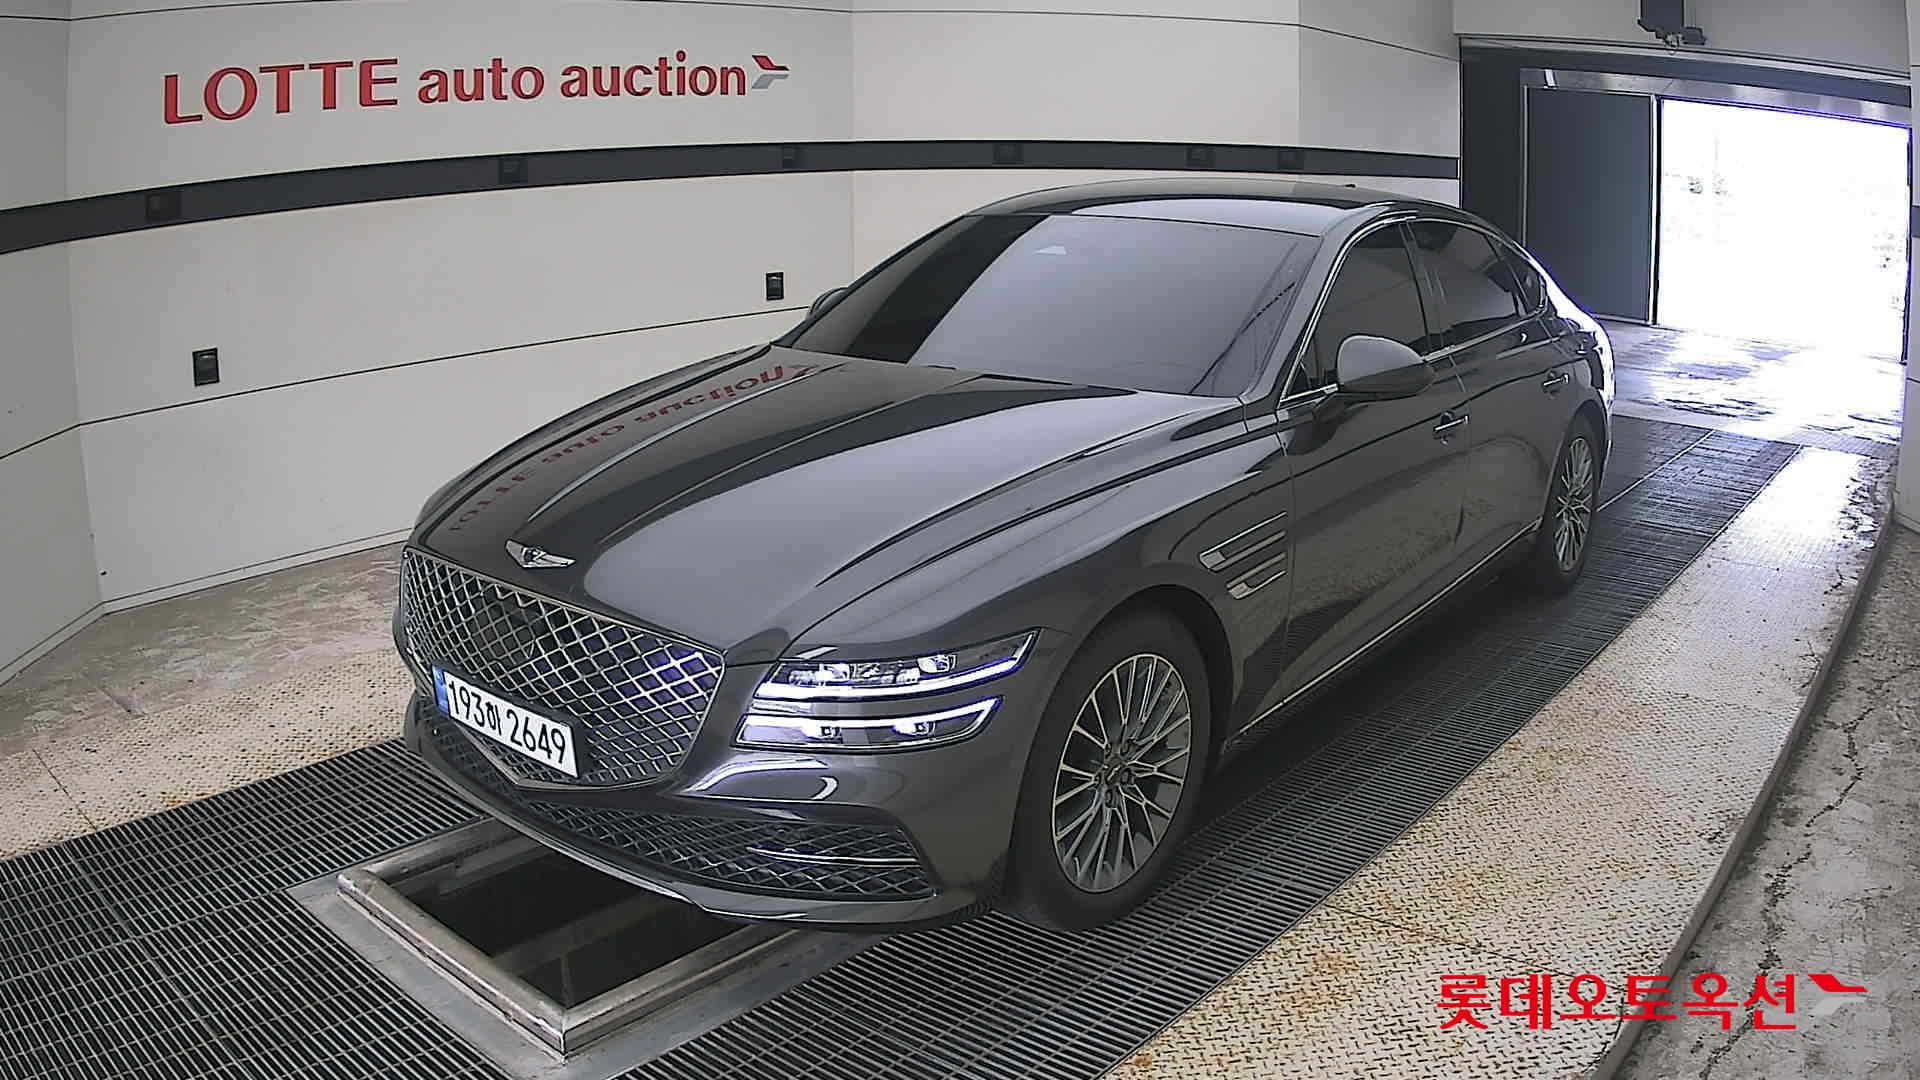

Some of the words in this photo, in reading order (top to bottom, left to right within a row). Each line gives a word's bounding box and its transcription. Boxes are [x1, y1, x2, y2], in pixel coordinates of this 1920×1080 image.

[164, 59, 398, 126] LOTTE
[418, 58, 545, 103] auto
[560, 51, 746, 97] auction
[448, 680, 502, 736] 193하
[506, 708, 567, 764] 2649
